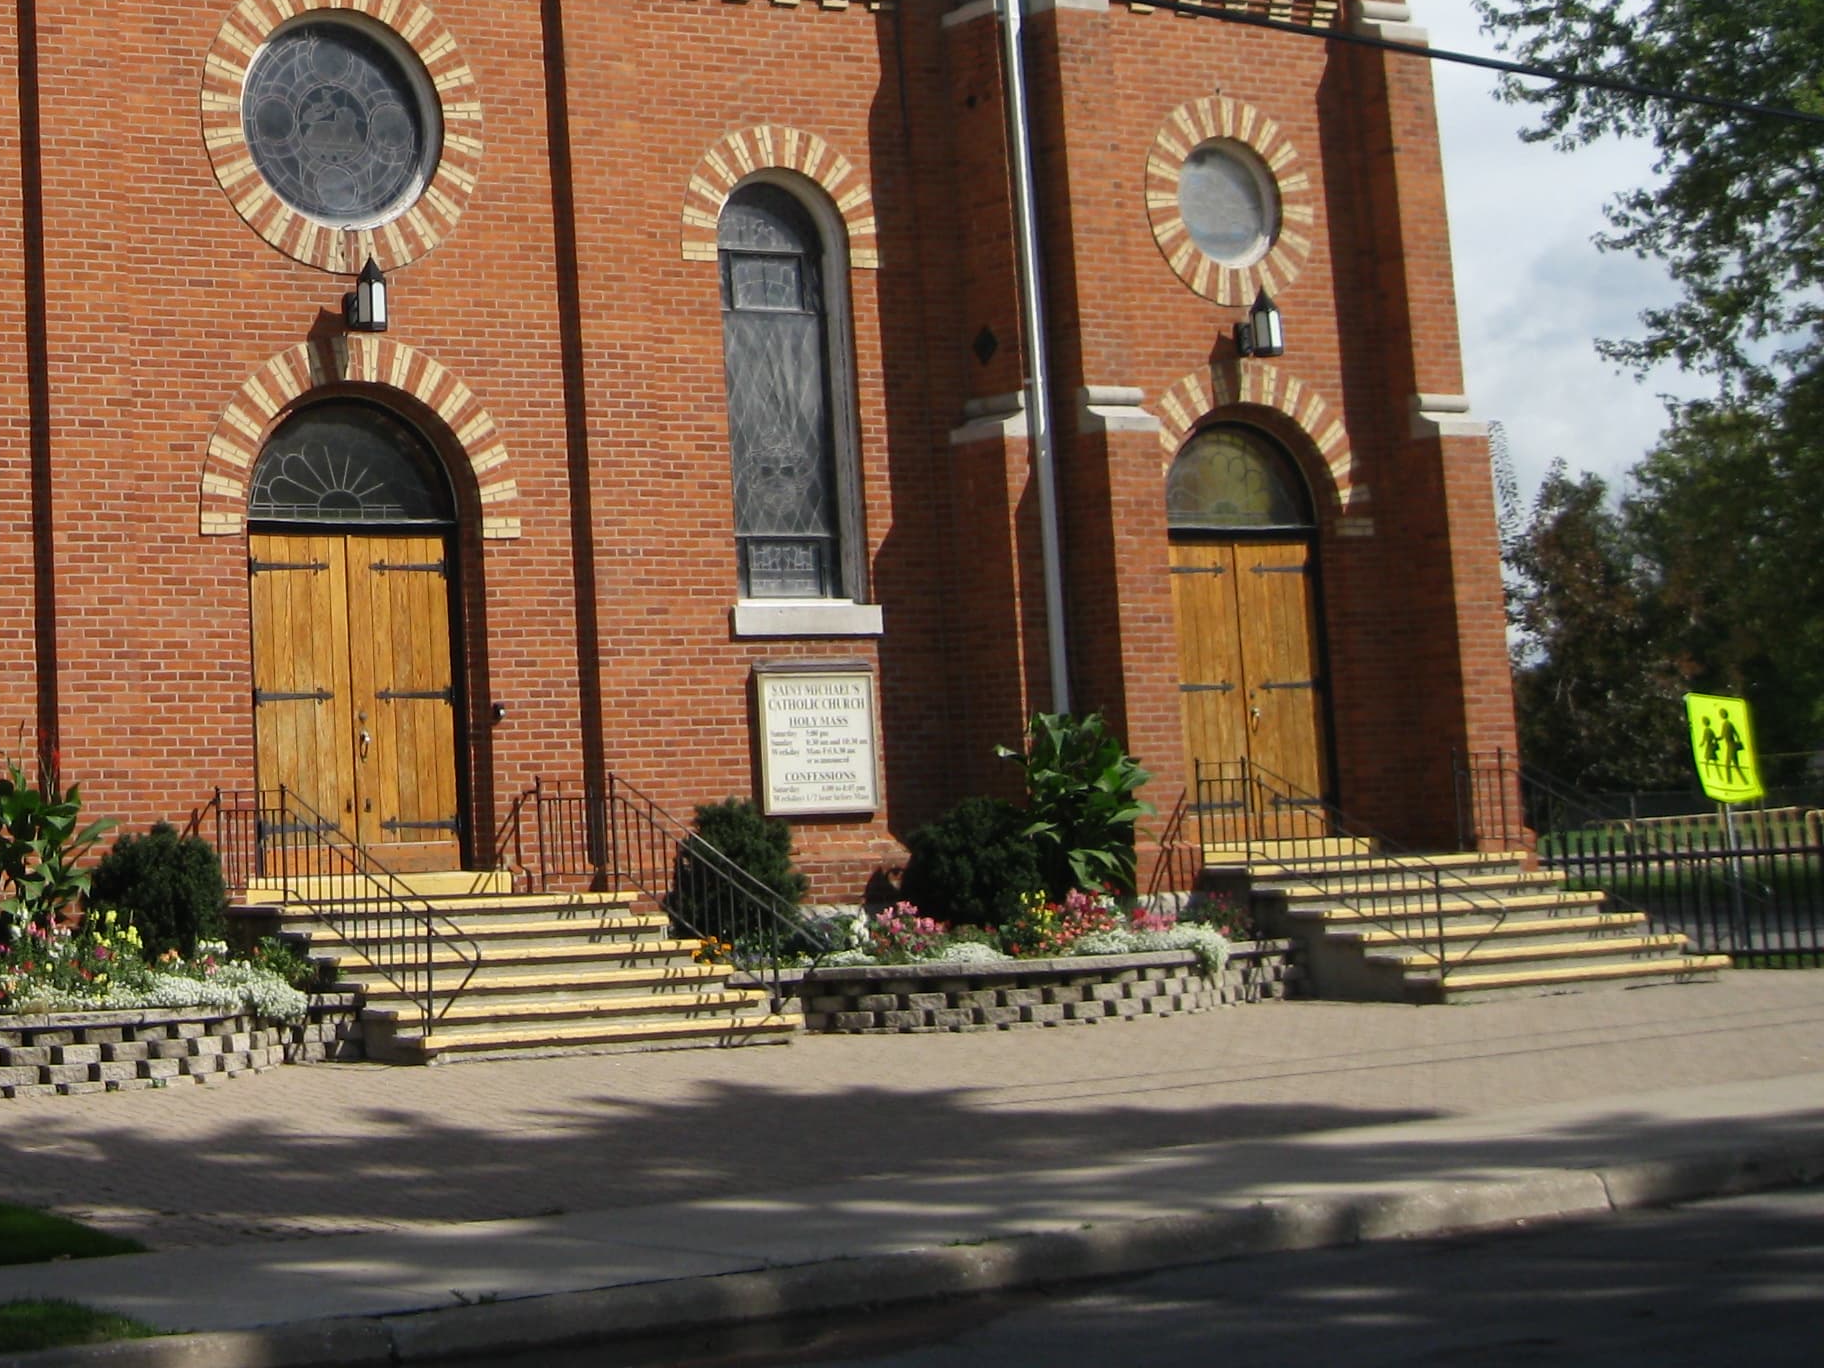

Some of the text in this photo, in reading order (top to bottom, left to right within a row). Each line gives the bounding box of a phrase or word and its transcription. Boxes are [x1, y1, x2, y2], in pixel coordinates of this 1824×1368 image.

[771, 684, 801, 696] SAINT
[768, 697, 865, 710] CATHOLIC CHURCH
[789, 715, 848, 726] HOLY MASS
[784, 772, 856, 781] CONFESSIONS
